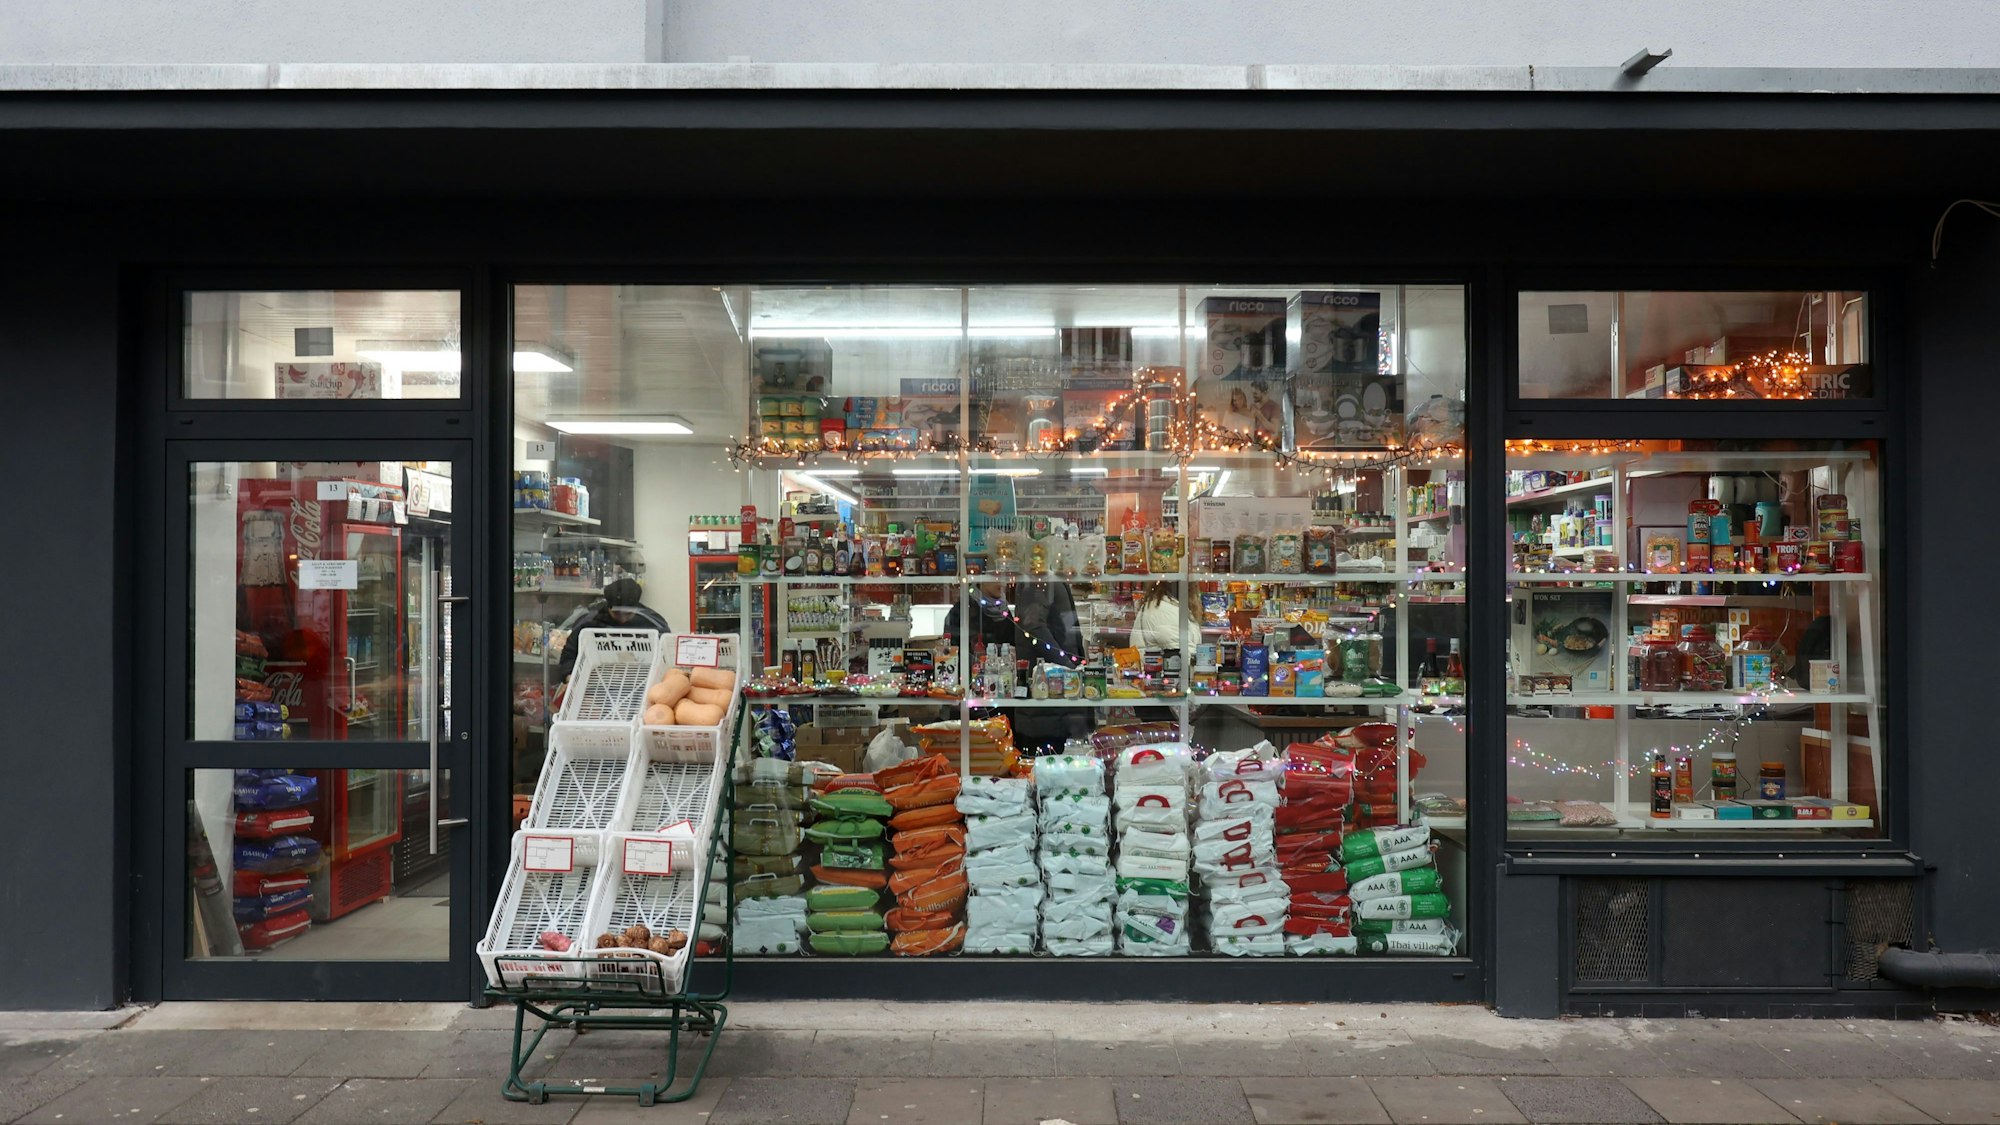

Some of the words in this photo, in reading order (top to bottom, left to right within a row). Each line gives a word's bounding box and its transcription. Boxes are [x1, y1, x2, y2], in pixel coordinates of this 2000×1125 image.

[1323, 295, 1359, 306] ricco
[1228, 301, 1265, 312] ricco
[921, 382, 956, 392] ricco
[535, 444, 545, 452] 13
[329, 484, 338, 492] 13
[1394, 835, 1411, 846] AAA
[1400, 853, 1418, 863] AAA
[1367, 883, 1385, 892] AAA
[1409, 923, 1427, 931] AAA
[1390, 940, 1412, 950] Thai
